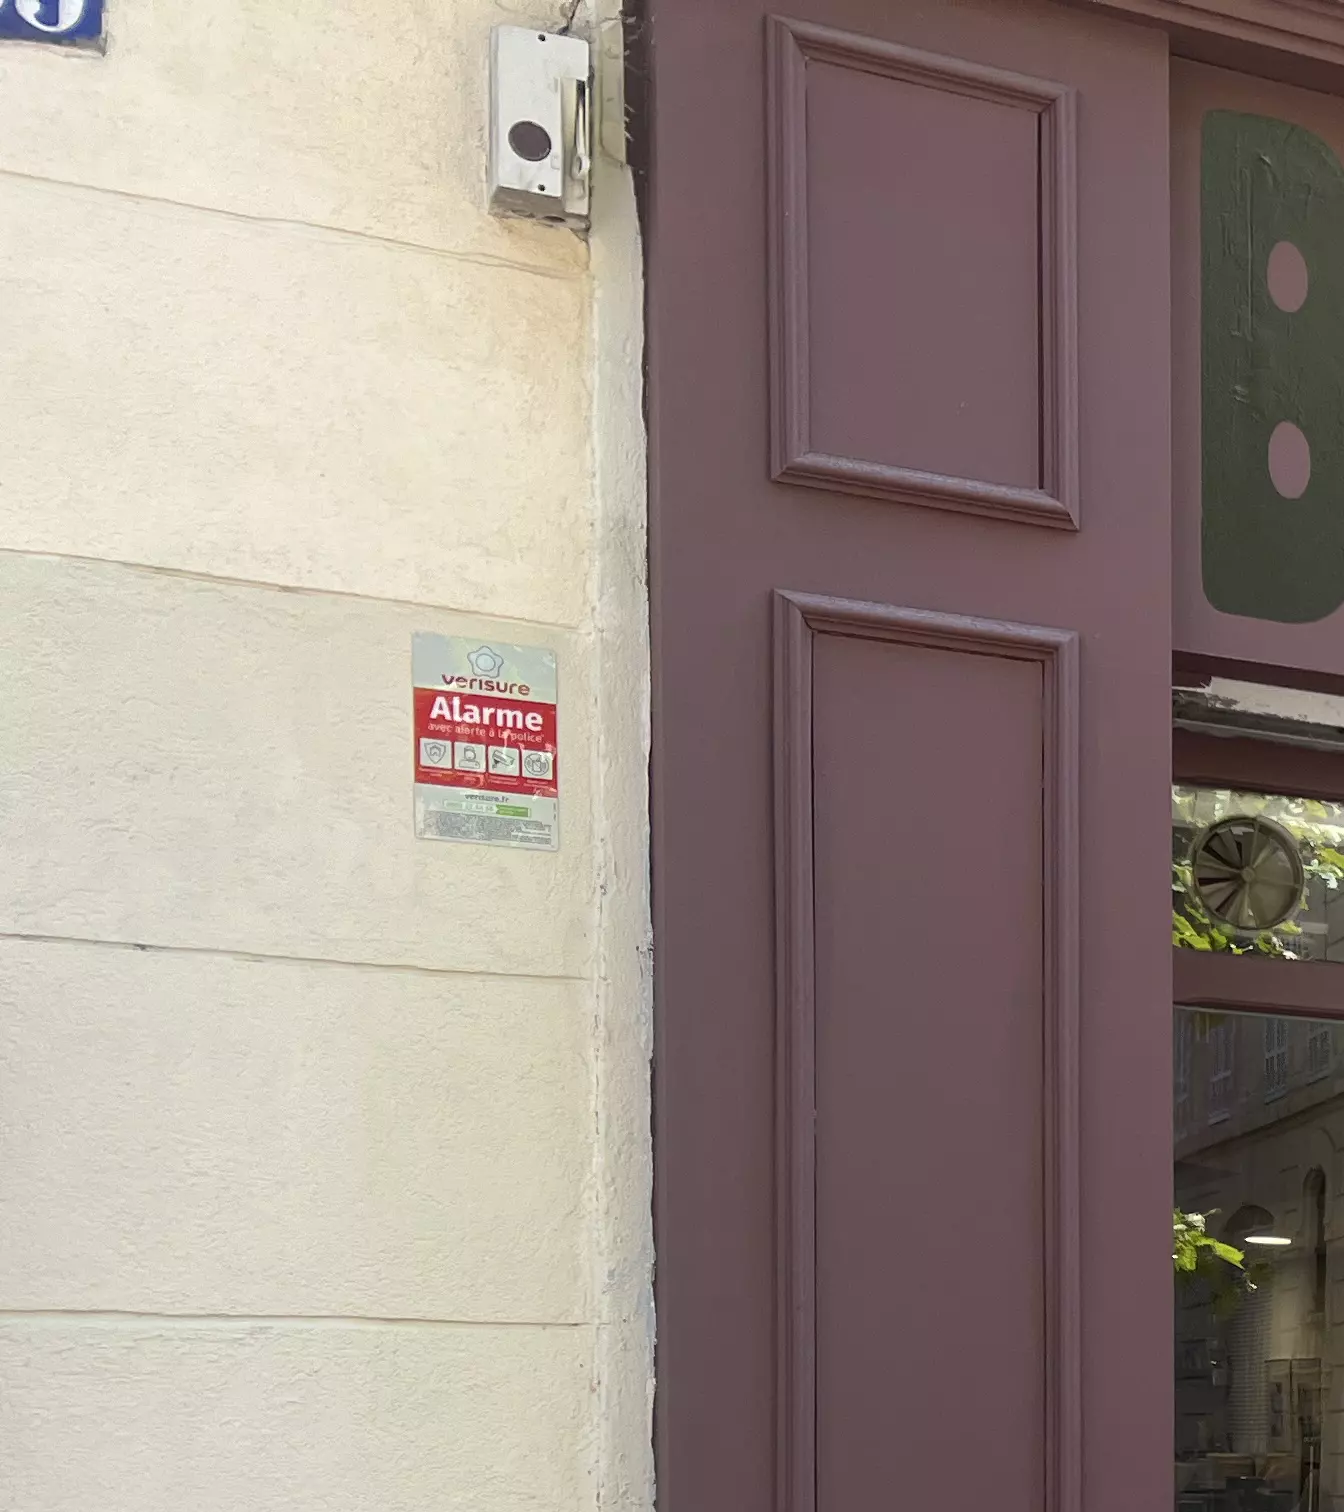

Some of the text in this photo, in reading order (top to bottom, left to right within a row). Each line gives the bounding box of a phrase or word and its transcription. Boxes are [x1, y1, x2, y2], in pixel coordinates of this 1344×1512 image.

[441, 673, 531, 696] verisure
[429, 696, 544, 732] Alarme
[427, 722, 453, 735] avec
[455, 724, 486, 737] alerte
